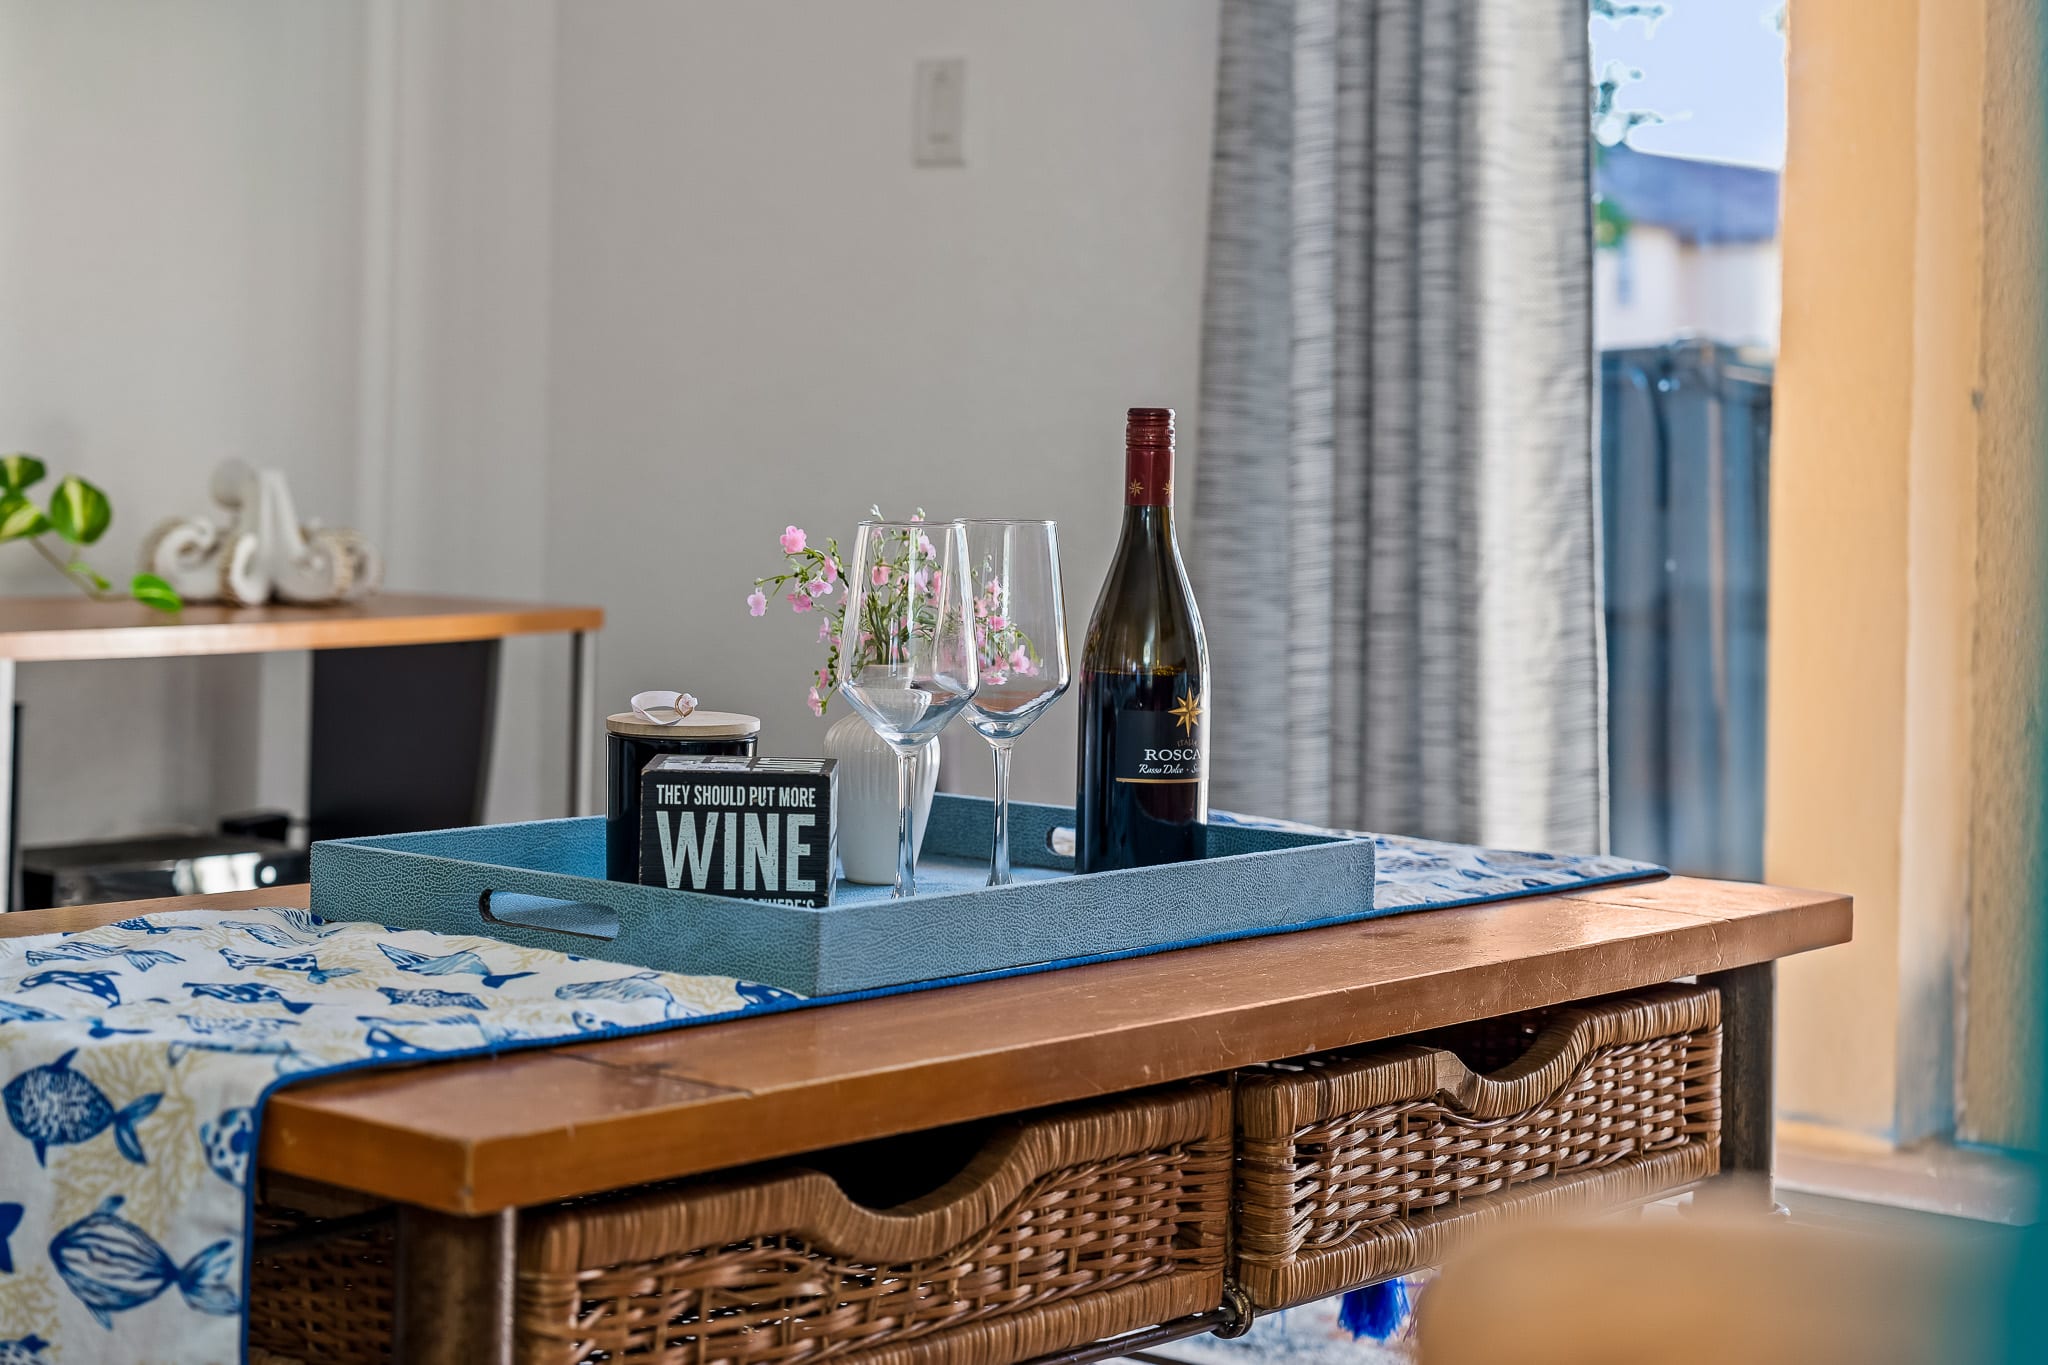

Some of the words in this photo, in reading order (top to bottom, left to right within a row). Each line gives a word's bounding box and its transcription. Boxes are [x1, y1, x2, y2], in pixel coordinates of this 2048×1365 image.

[1143, 748, 1201, 761] ROSCA
[656, 784, 690, 805] THEY
[693, 785, 746, 807] SHOULD
[749, 786, 776, 808] PUT
[778, 787, 816, 808] MORE
[656, 810, 816, 892] WINE
